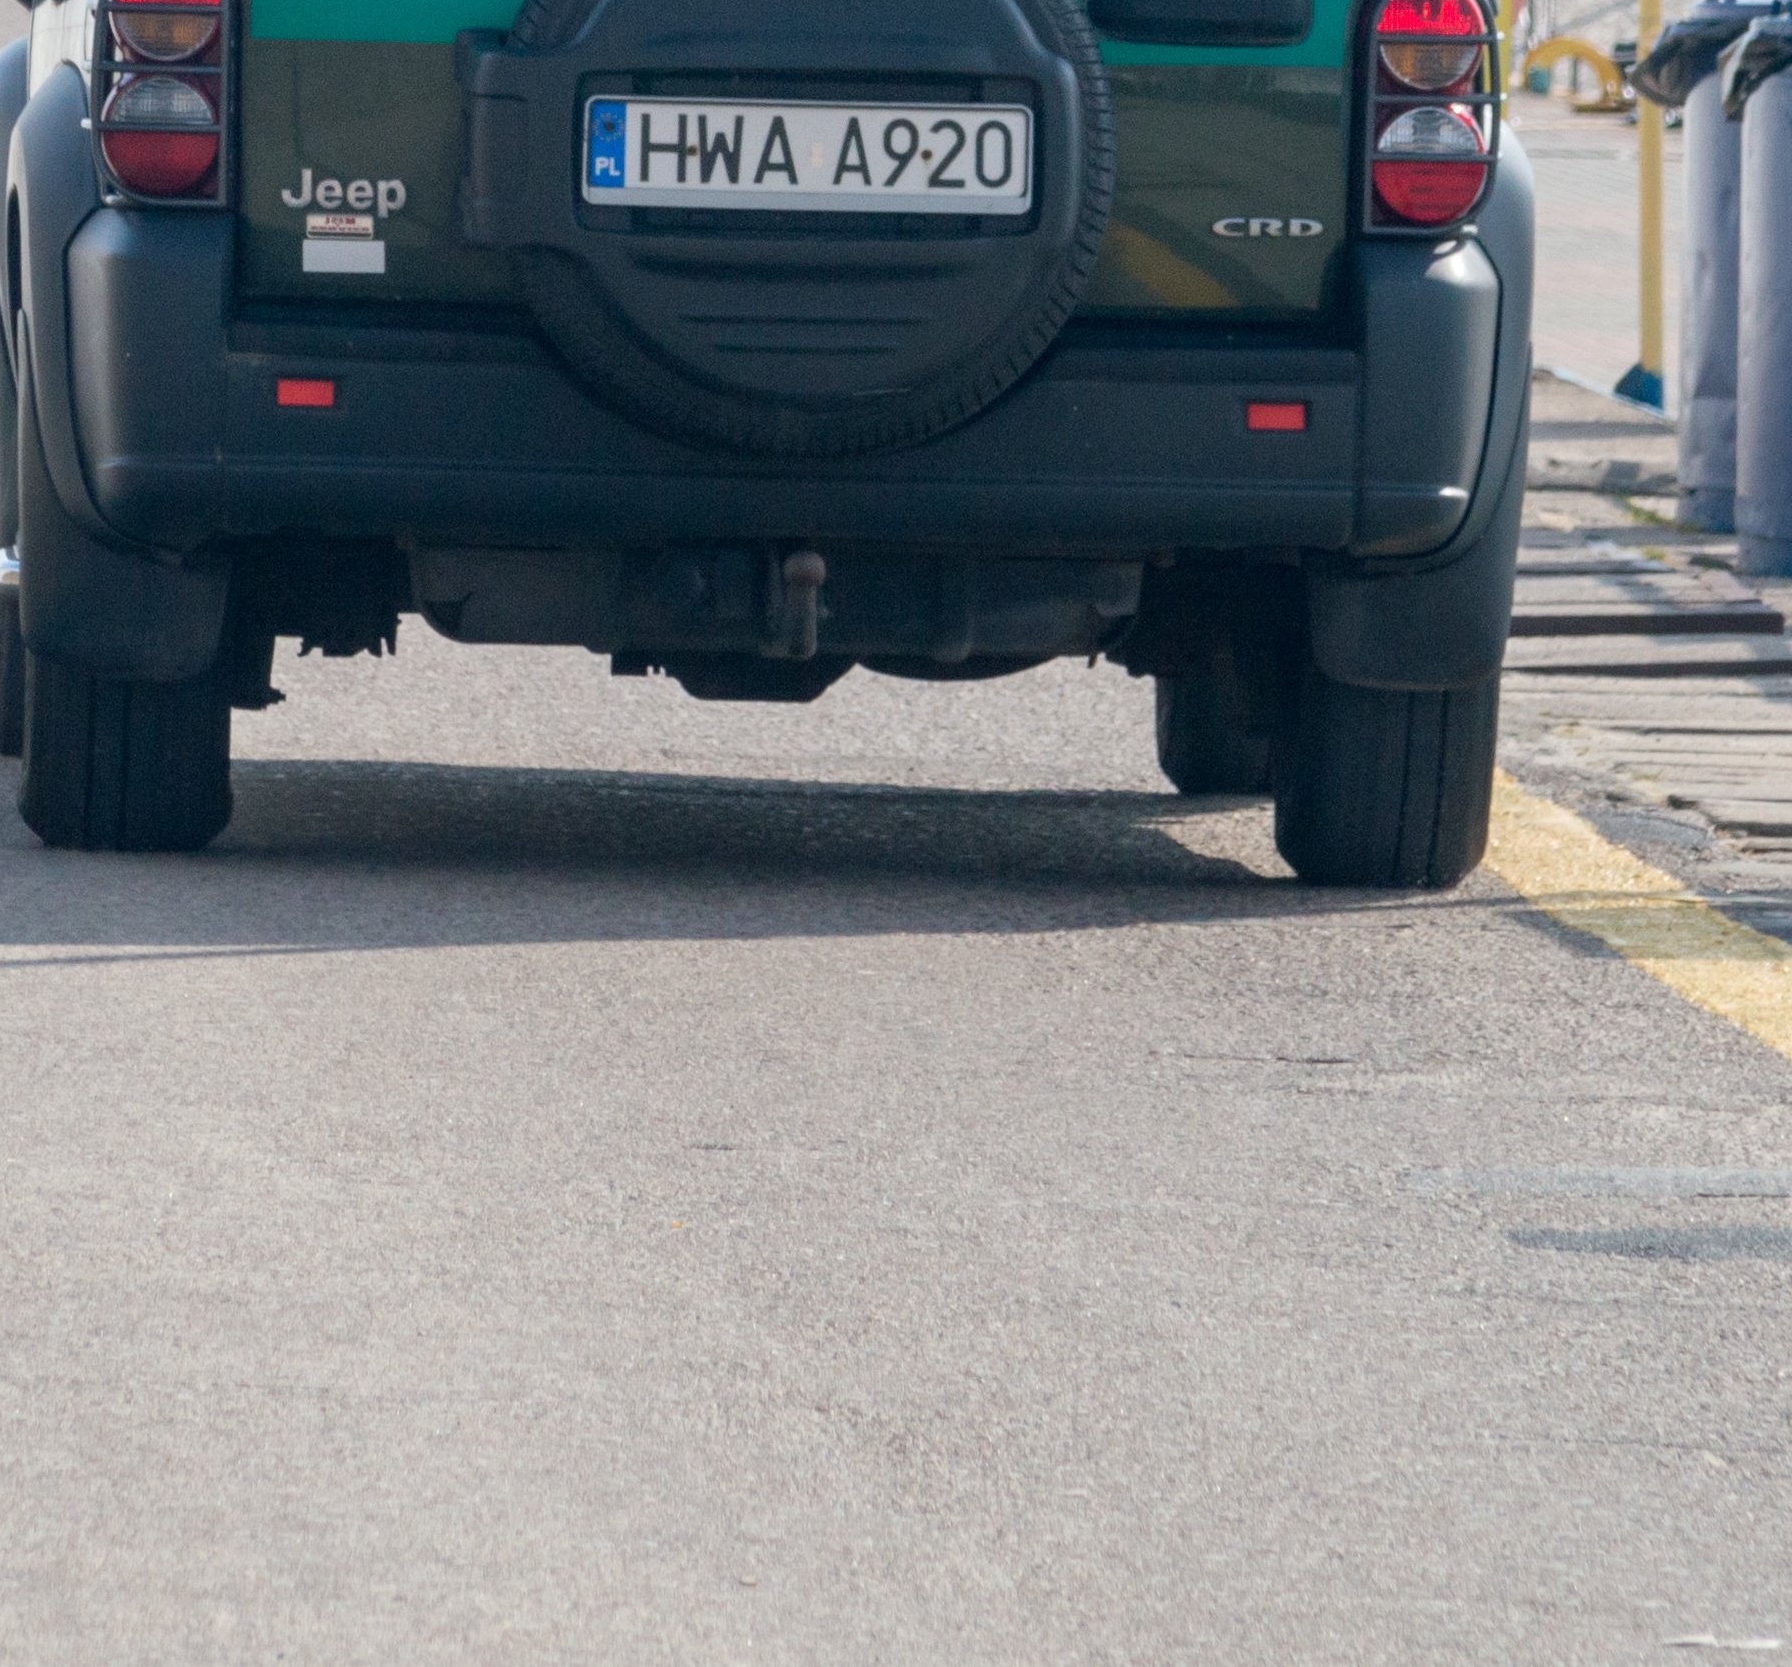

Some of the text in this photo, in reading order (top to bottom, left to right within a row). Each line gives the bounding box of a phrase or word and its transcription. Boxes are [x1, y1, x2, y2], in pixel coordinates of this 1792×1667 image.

[594, 155, 621, 176] PL
[639, 112, 1013, 189] HWA A920
[281, 168, 407, 219] Jeep
[1212, 217, 1324, 237] CRD
